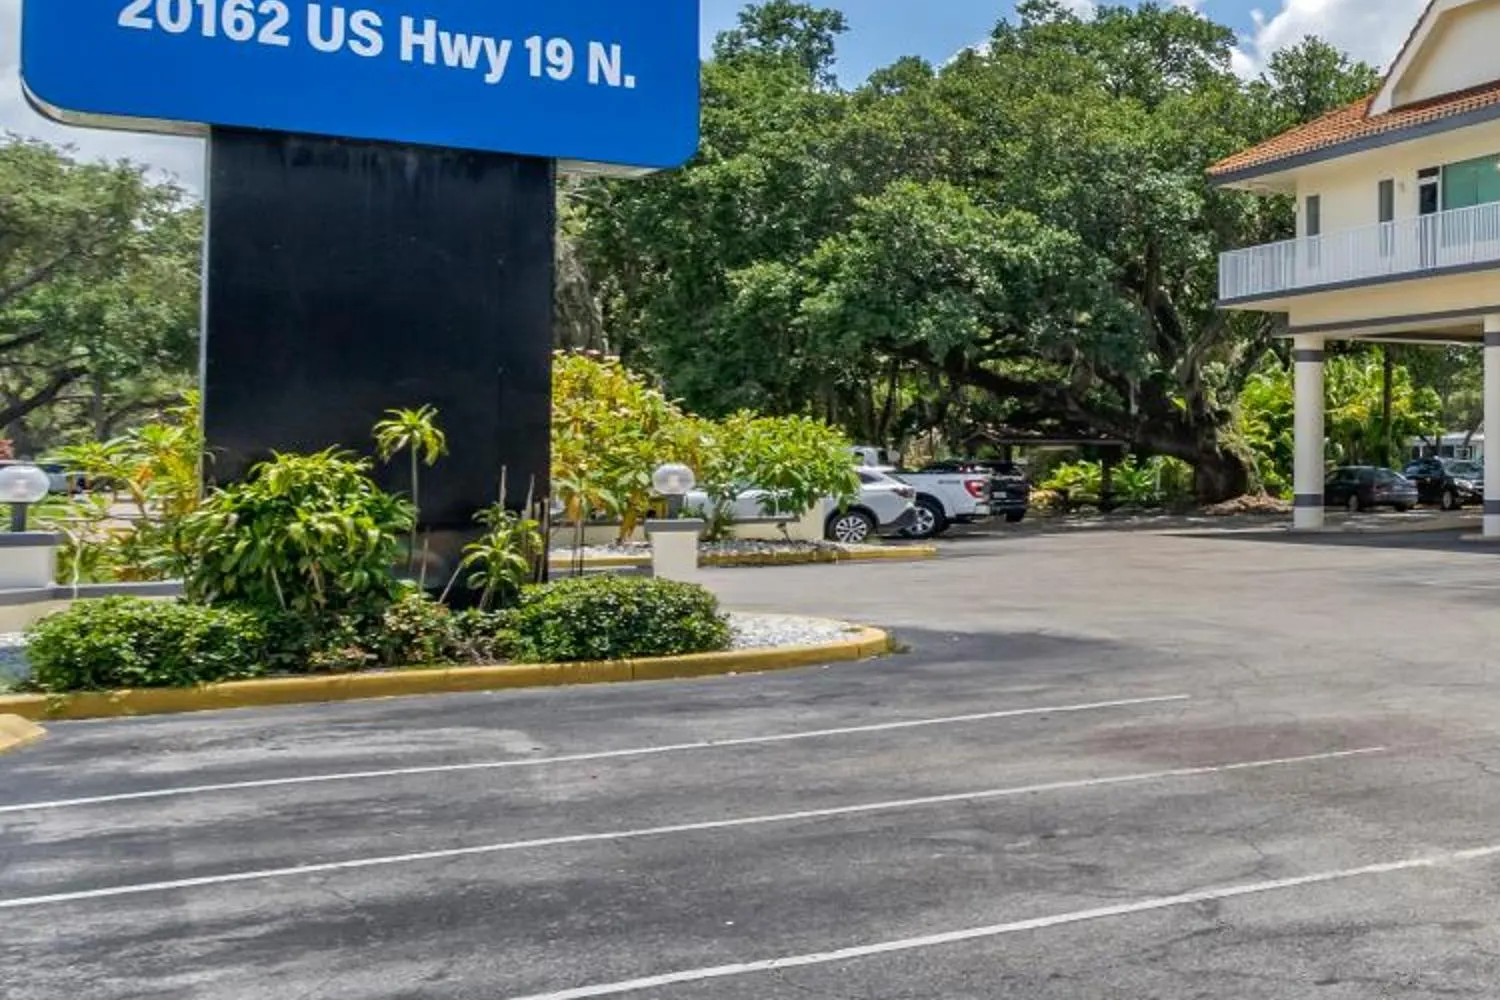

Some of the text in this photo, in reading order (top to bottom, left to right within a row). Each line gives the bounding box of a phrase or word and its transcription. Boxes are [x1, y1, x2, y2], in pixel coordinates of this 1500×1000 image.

[306, 3, 384, 58] US
[399, 15, 512, 85] Hwy
[524, 35, 574, 81] 19
[587, 41, 636, 89] N.
